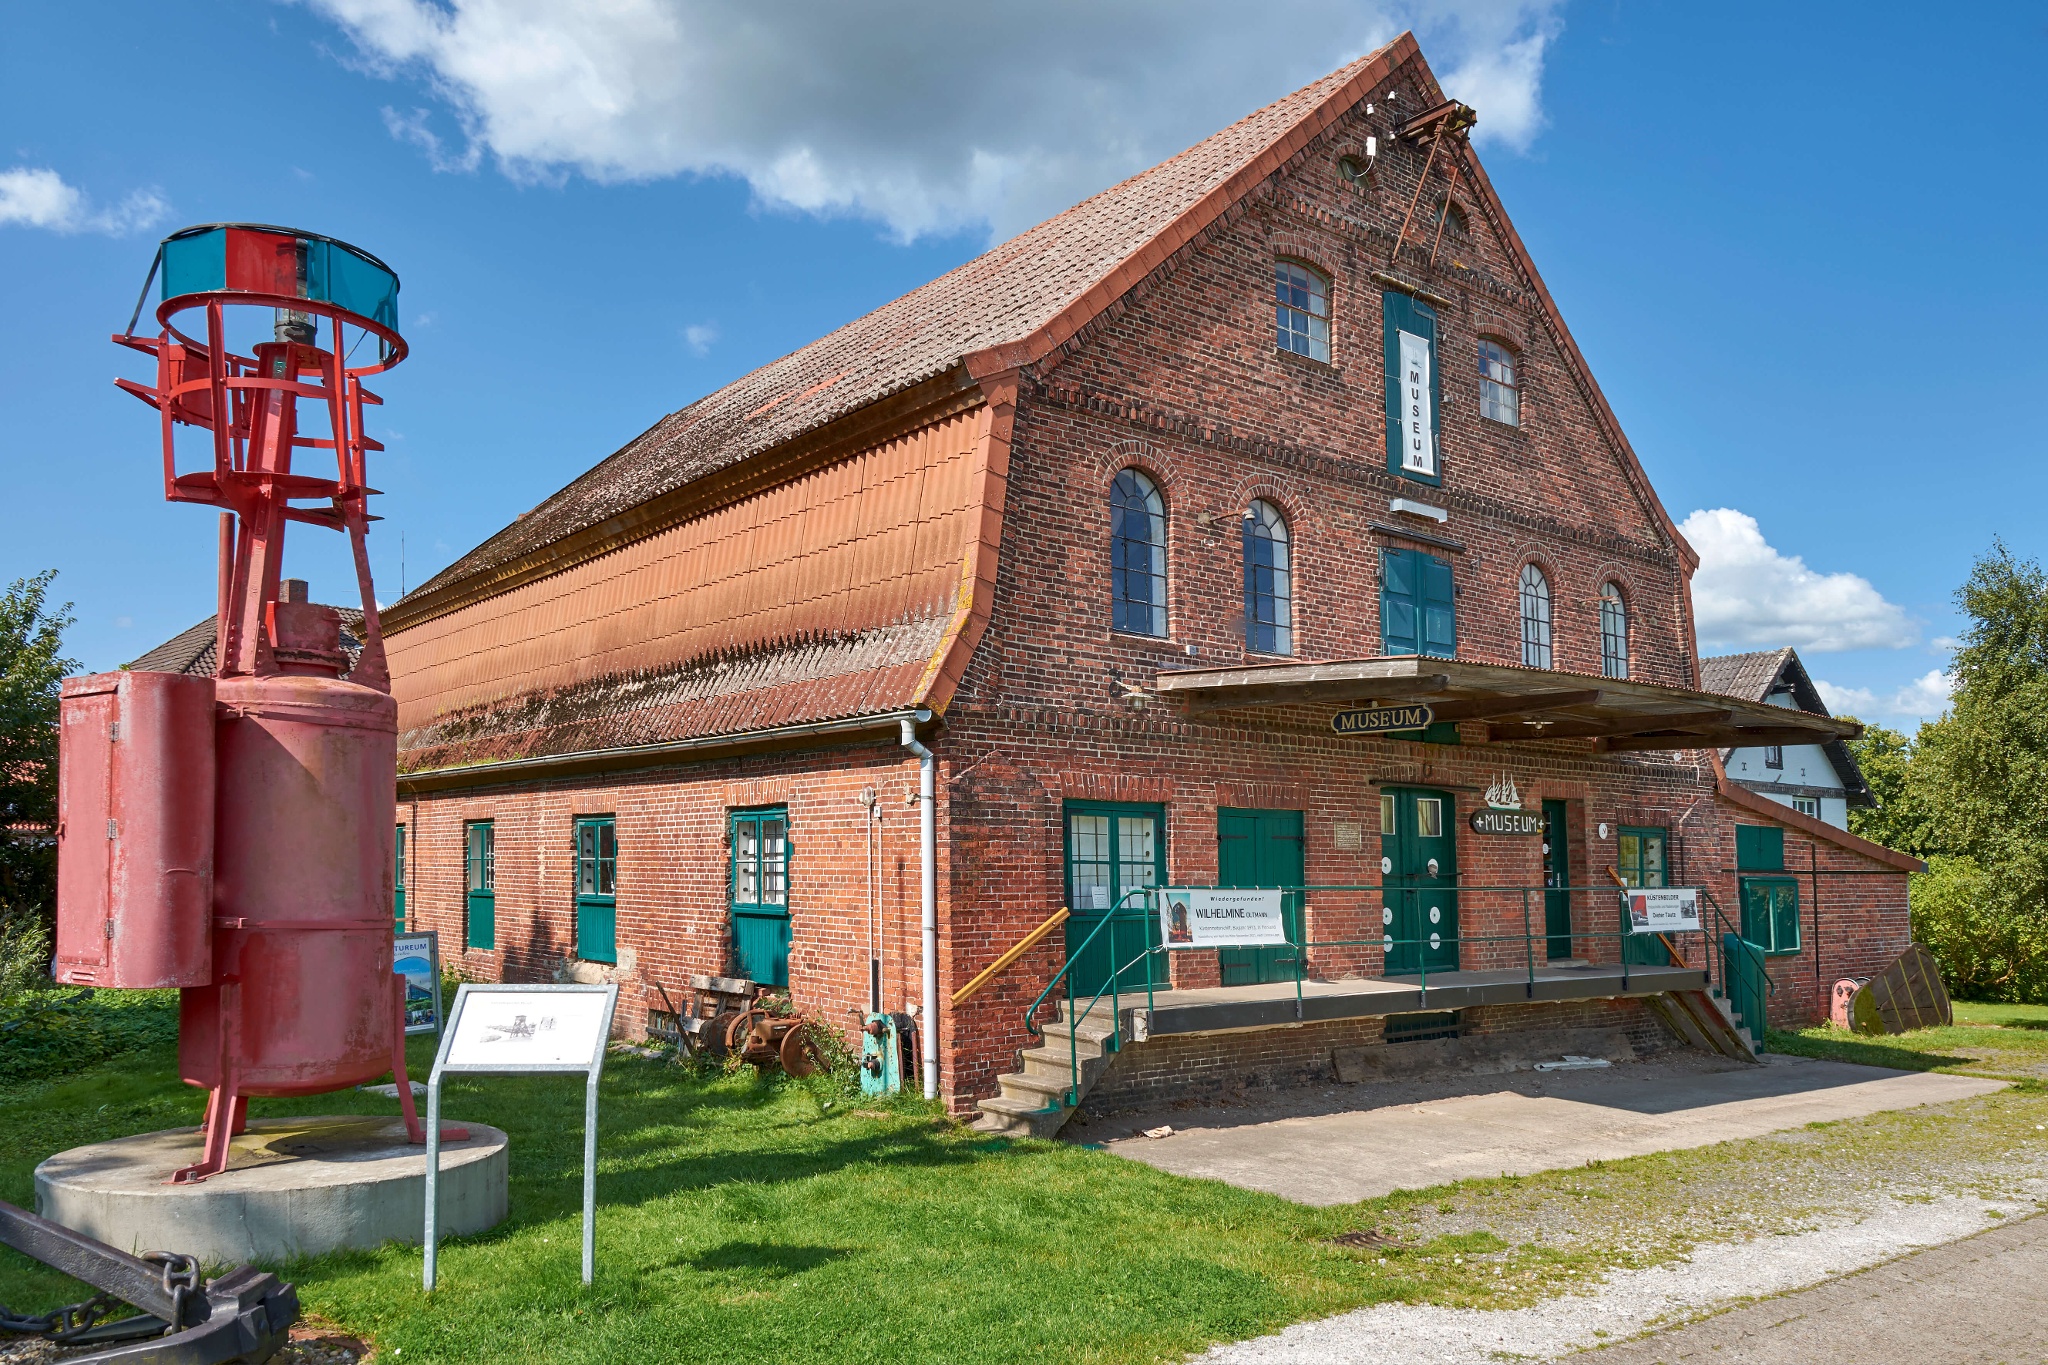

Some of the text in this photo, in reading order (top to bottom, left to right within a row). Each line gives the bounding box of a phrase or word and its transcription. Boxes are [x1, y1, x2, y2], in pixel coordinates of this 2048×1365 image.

[1410, 370, 1423, 468] MUSEUM
[1340, 707, 1422, 730] MUSEUM
[1485, 814, 1537, 833] MUSEUM
[1195, 908, 1245, 918] WILHELMINE
[394, 943, 427, 951] TUREUM
